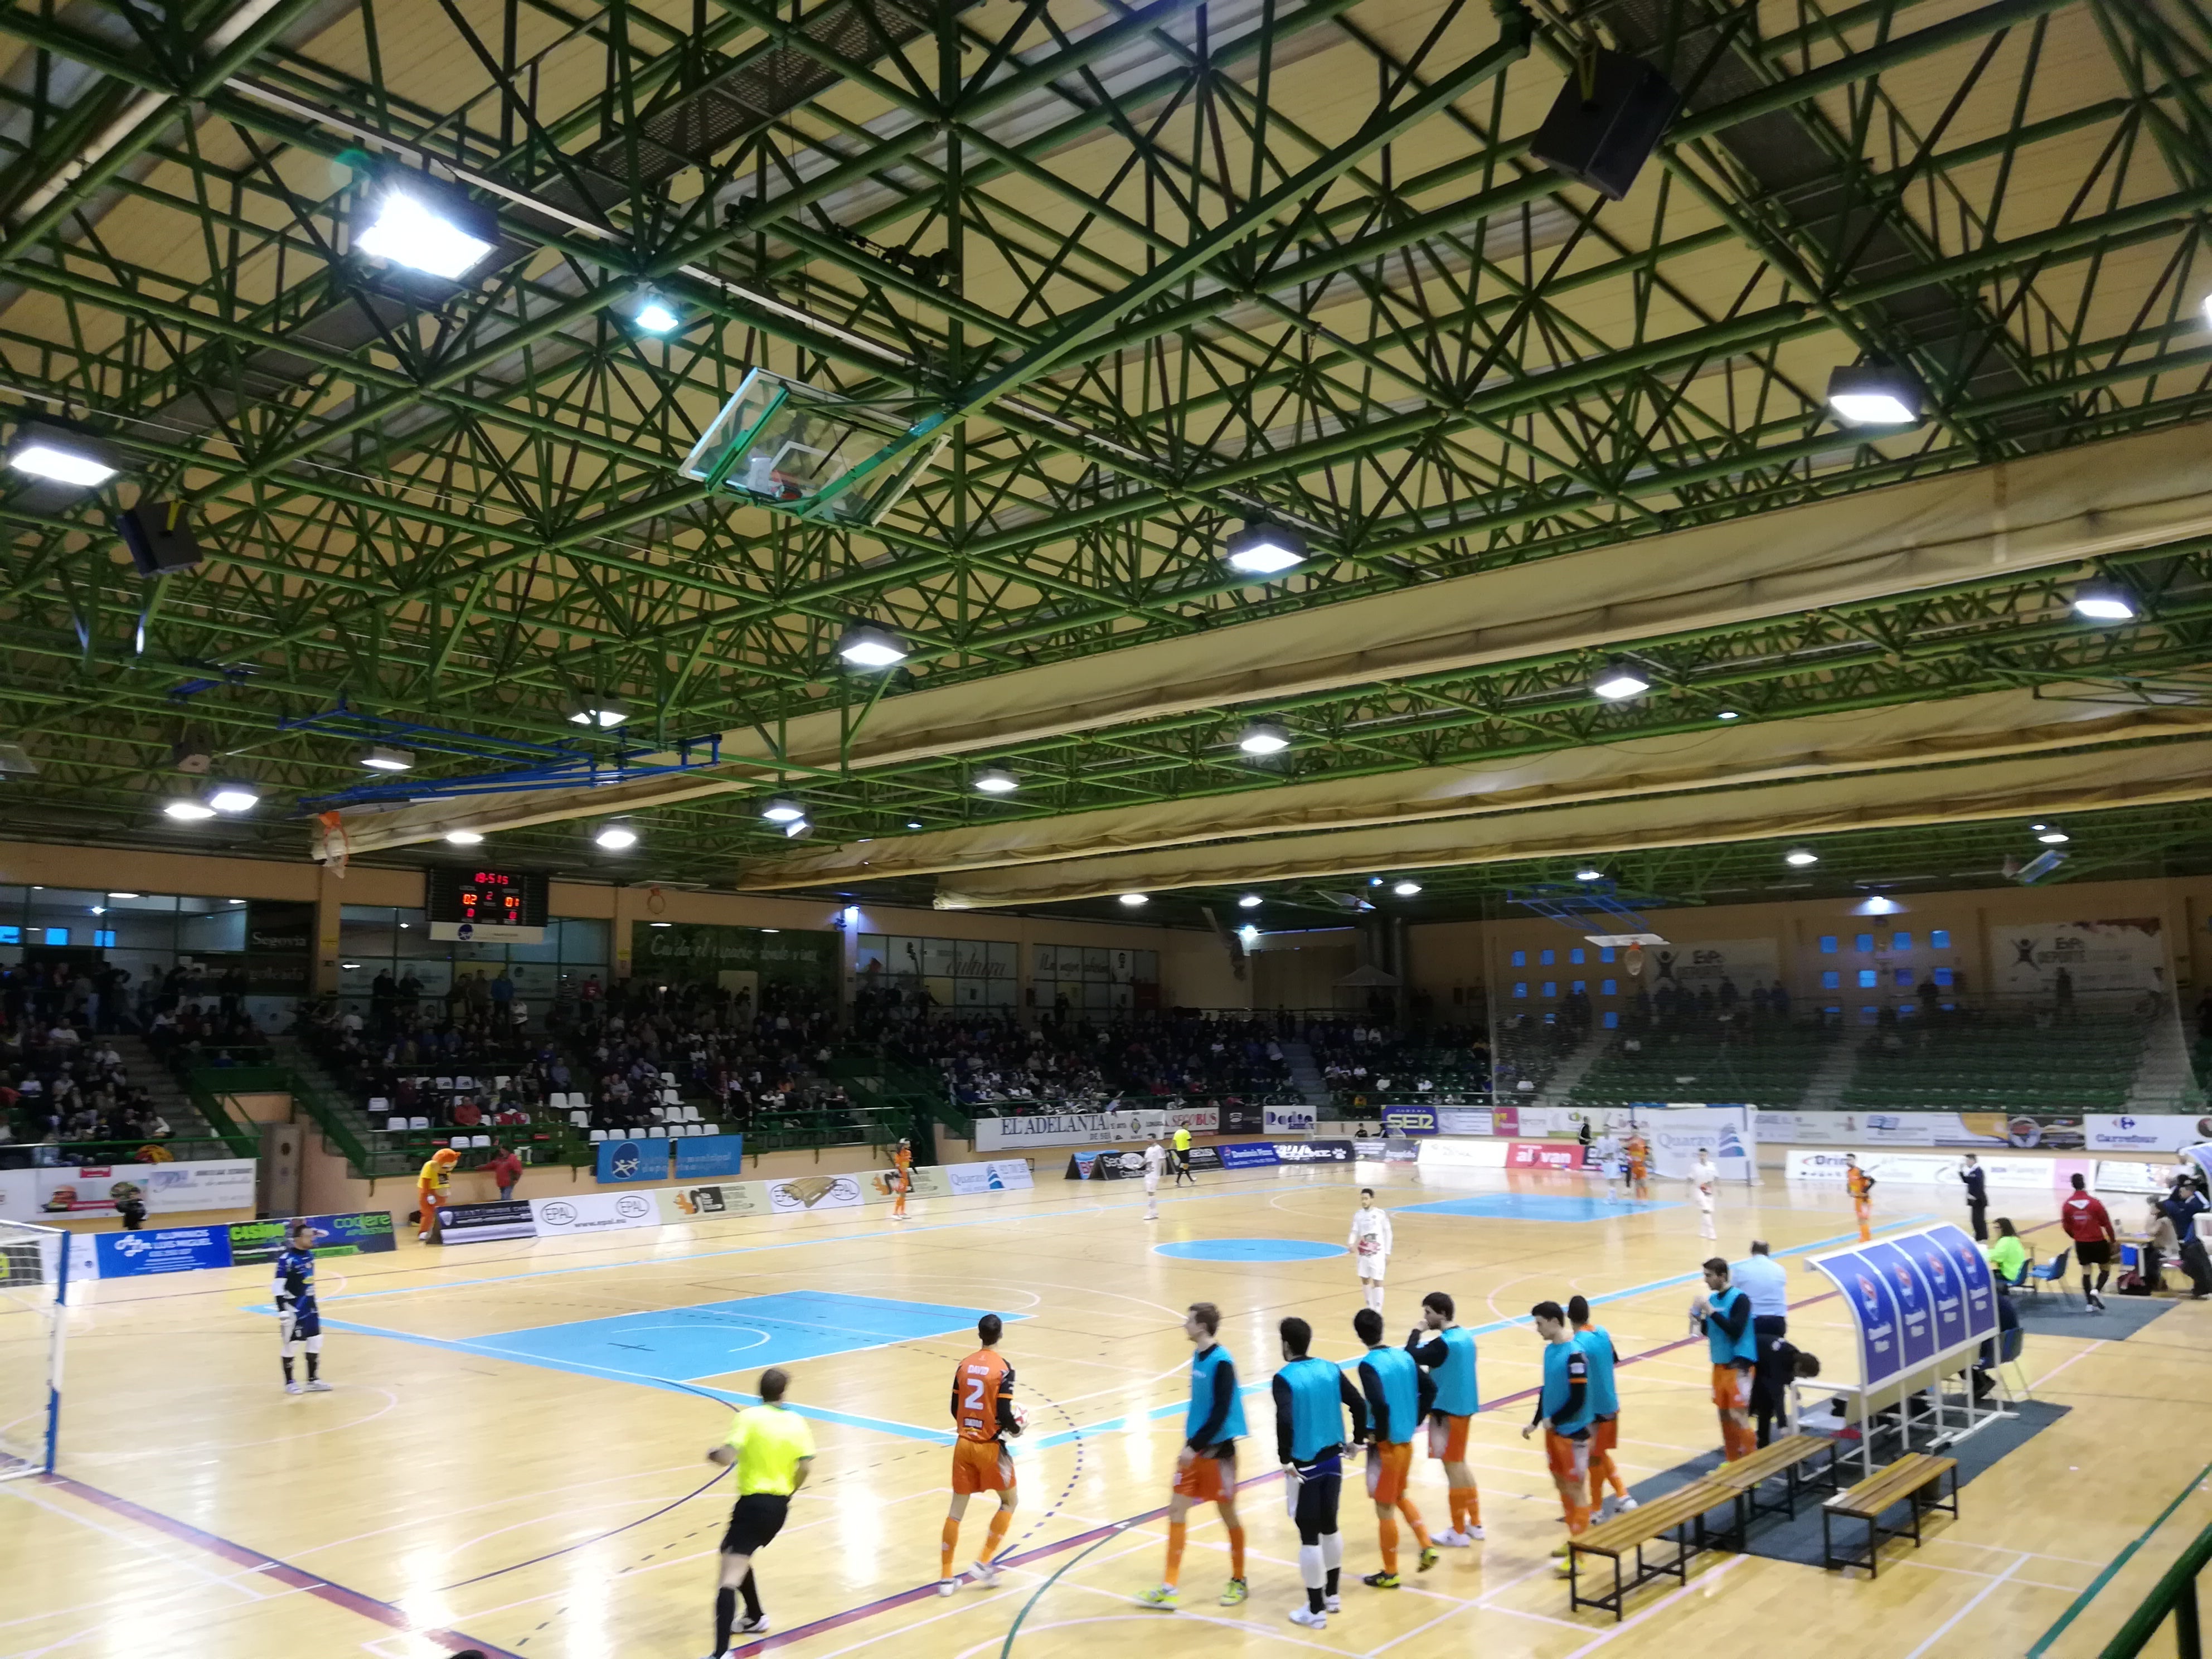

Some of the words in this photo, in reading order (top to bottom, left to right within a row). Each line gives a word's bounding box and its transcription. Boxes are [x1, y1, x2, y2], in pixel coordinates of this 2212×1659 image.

[463, 894, 477, 905] 02
[505, 896, 520, 907] 01
[252, 932, 307, 947] Segovia
[1001, 1118, 1022, 1136] EL
[1386, 1114, 1435, 1129] SER
[619, 1200, 646, 1213] EPAL
[545, 1207, 574, 1221] EPAL
[967, 1364, 990, 1375] DAVID
[964, 1378, 984, 1410] 2
